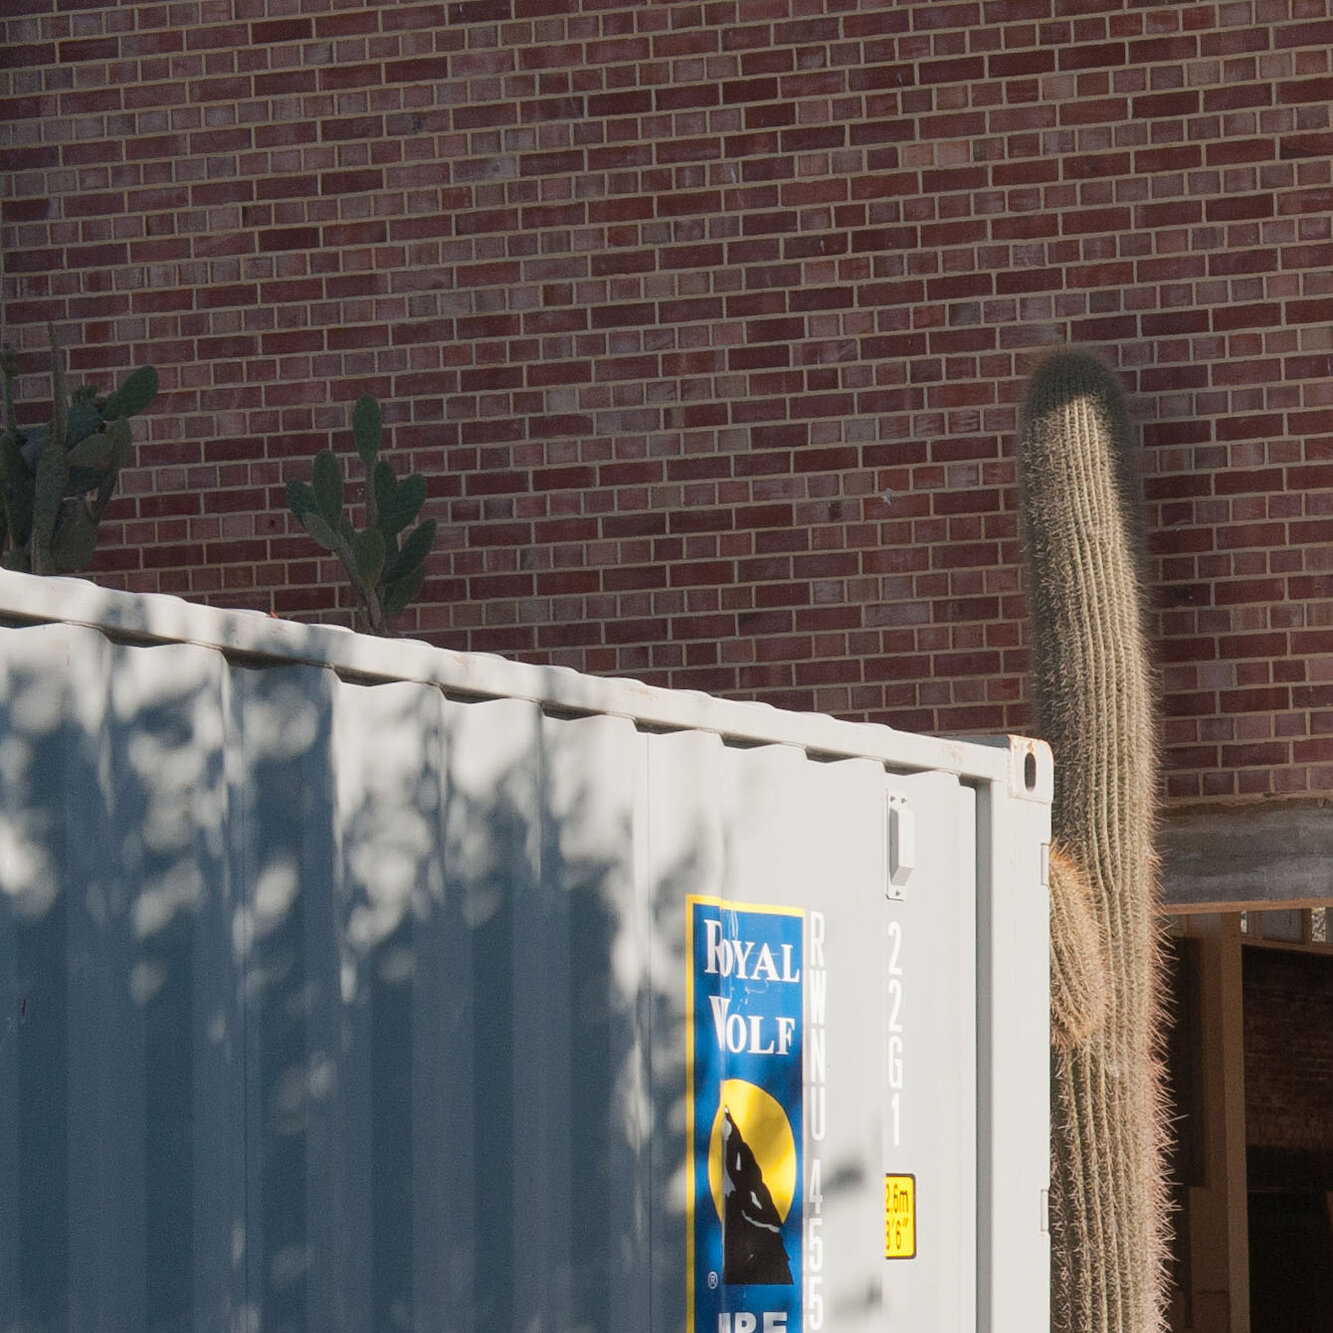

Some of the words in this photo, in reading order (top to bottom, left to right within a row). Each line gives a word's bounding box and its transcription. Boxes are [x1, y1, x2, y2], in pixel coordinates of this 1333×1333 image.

[704, 918, 800, 983] ROYAL
[709, 995, 796, 1055] WOLF
[809, 911, 826, 1141] RWNU
[887, 921, 904, 1146] 22G1
